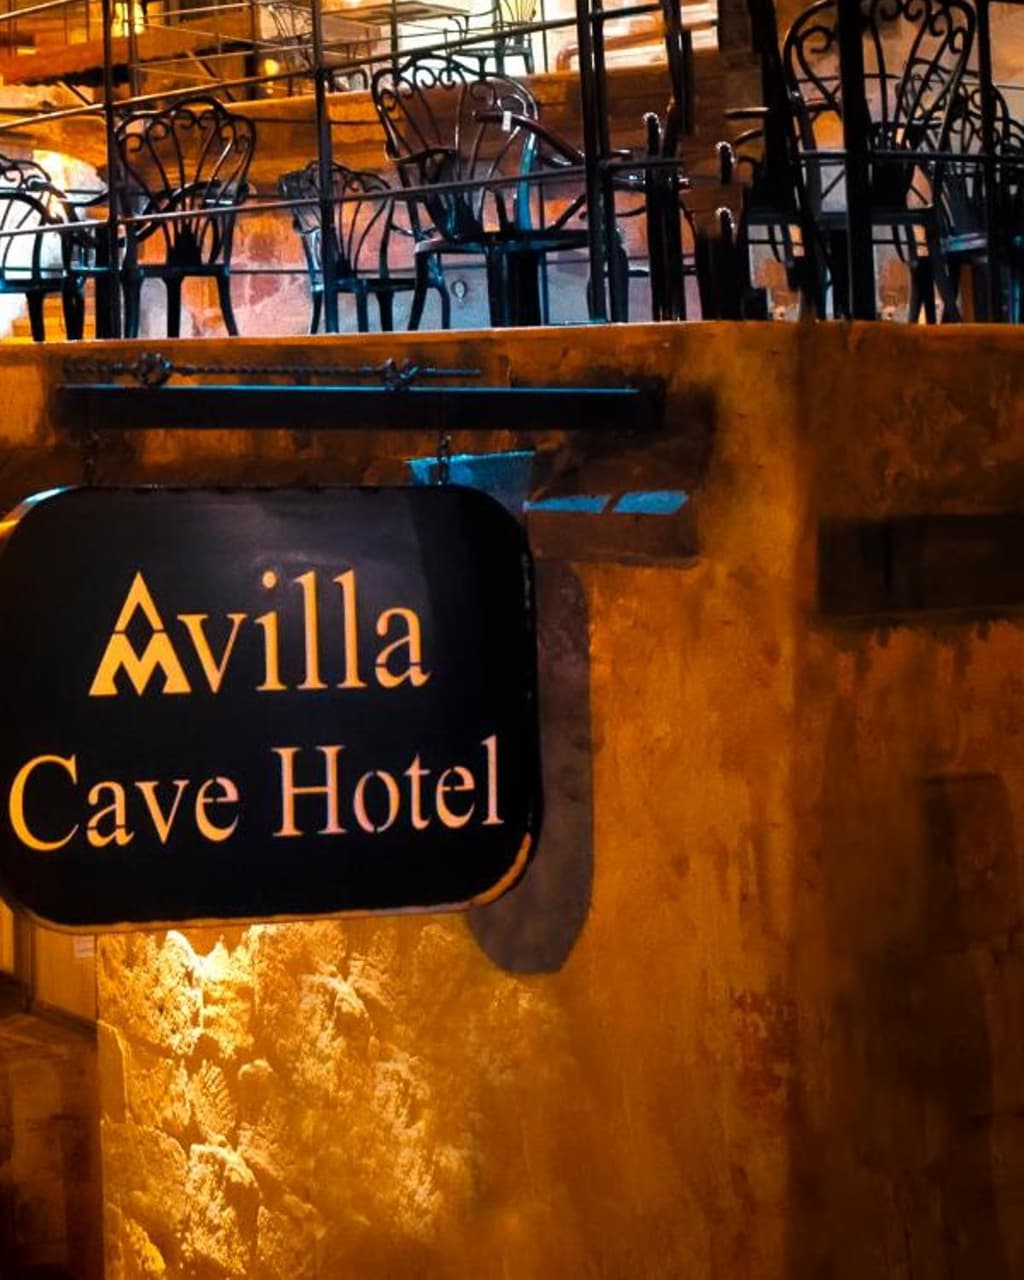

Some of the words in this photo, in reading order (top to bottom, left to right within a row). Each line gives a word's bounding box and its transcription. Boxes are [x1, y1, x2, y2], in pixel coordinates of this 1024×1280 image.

[88, 569, 432, 697] Avilla
[8, 754, 239, 851] Cave
[272, 735, 504, 837] Hotel
